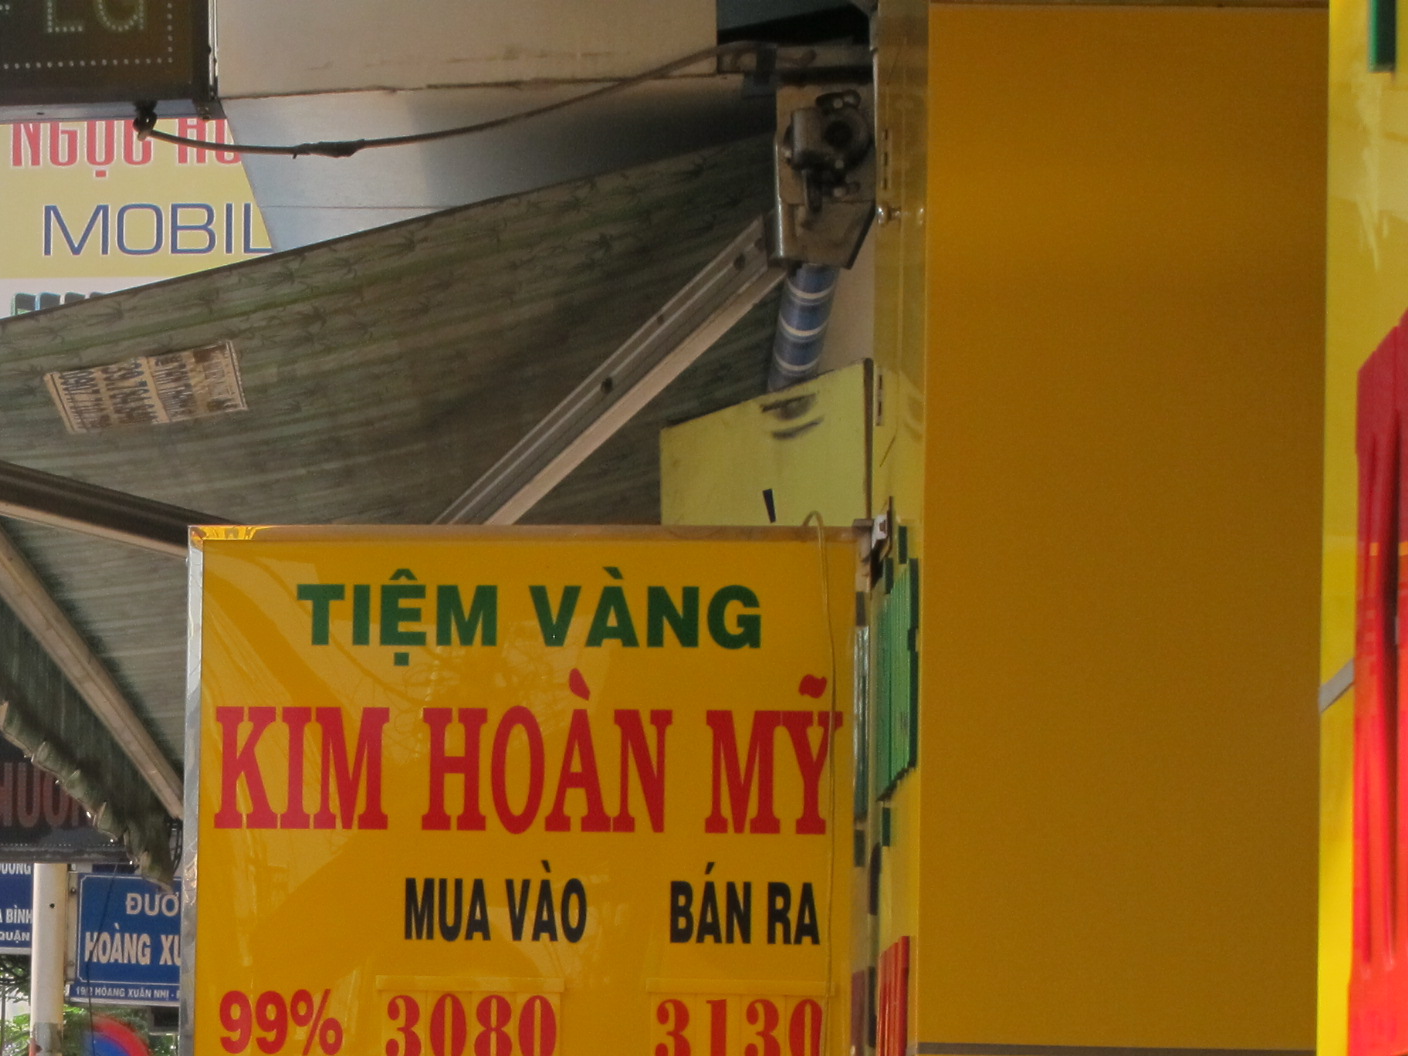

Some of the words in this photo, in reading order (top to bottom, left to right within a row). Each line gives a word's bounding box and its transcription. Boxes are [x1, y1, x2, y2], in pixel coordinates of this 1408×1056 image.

[297, 567, 498, 667] TIỆM
[529, 566, 762, 650] VÀNG
[213, 705, 391, 831] KIM
[421, 667, 674, 835] HOÀN
[704, 673, 844, 836] MỸ
[84, 922, 151, 965] HOÀNG
[403, 876, 492, 943] MUA
[504, 859, 588, 944] VÀO
[668, 861, 752, 944] BÁN
[766, 880, 821, 946] RA
[219, 988, 344, 1056] 99%
